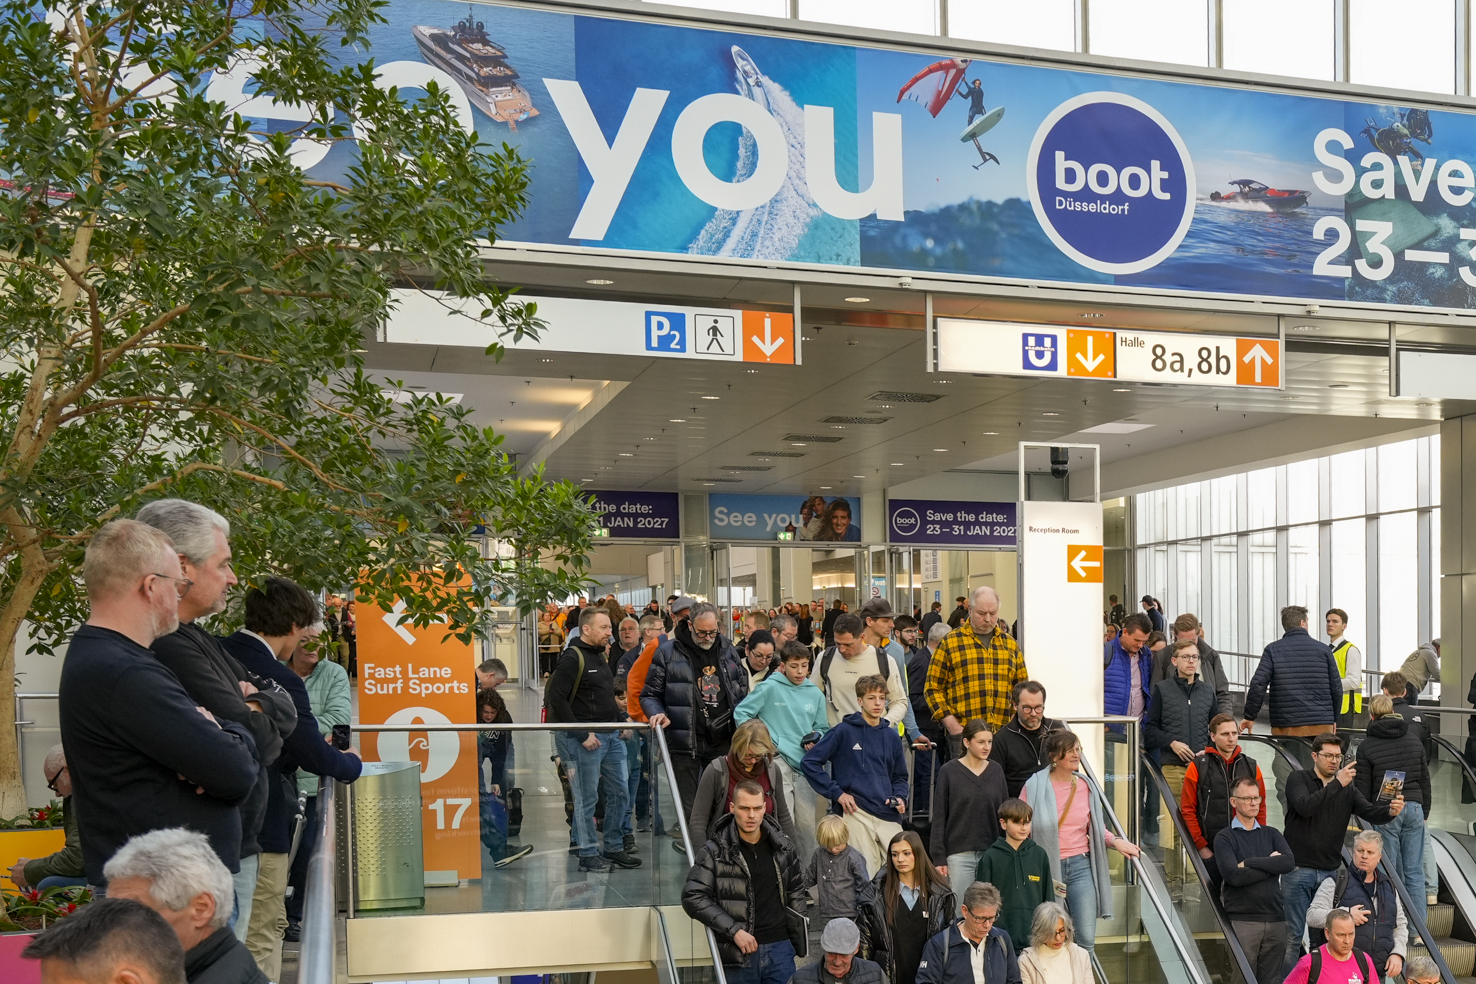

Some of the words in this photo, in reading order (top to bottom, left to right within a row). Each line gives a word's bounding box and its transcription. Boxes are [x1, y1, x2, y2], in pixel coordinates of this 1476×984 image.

[542, 77, 905, 243] you
[1312, 127, 1476, 207] Save
[1055, 150, 1170, 201] boot
[1055, 195, 1130, 215] Düsseldorf
[651, 316, 681, 349] P2
[1120, 336, 1146, 349] Halle
[1151, 343, 1231, 378] 8a,8b
[595, 501, 617, 513] the
[620, 502, 653, 514] date:
[926, 509, 953, 522] Save
[957, 510, 976, 522] the
[978, 511, 1007, 523] date:
[607, 517, 633, 528] JAN
[637, 518, 669, 529] 2027
[714, 506, 757, 527] See
[763, 513, 804, 532] you
[897, 516, 916, 525] boot
[926, 525, 941, 535] 23
[952, 525, 964, 535] 31
[967, 525, 990, 536] JAN
[1029, 526, 1060, 535] Reception
[364, 663, 402, 679] Fast
[407, 663, 452, 678] Lane
[364, 679, 403, 695] Surf
[408, 679, 469, 697] Sports
[428, 797, 472, 830] 17
